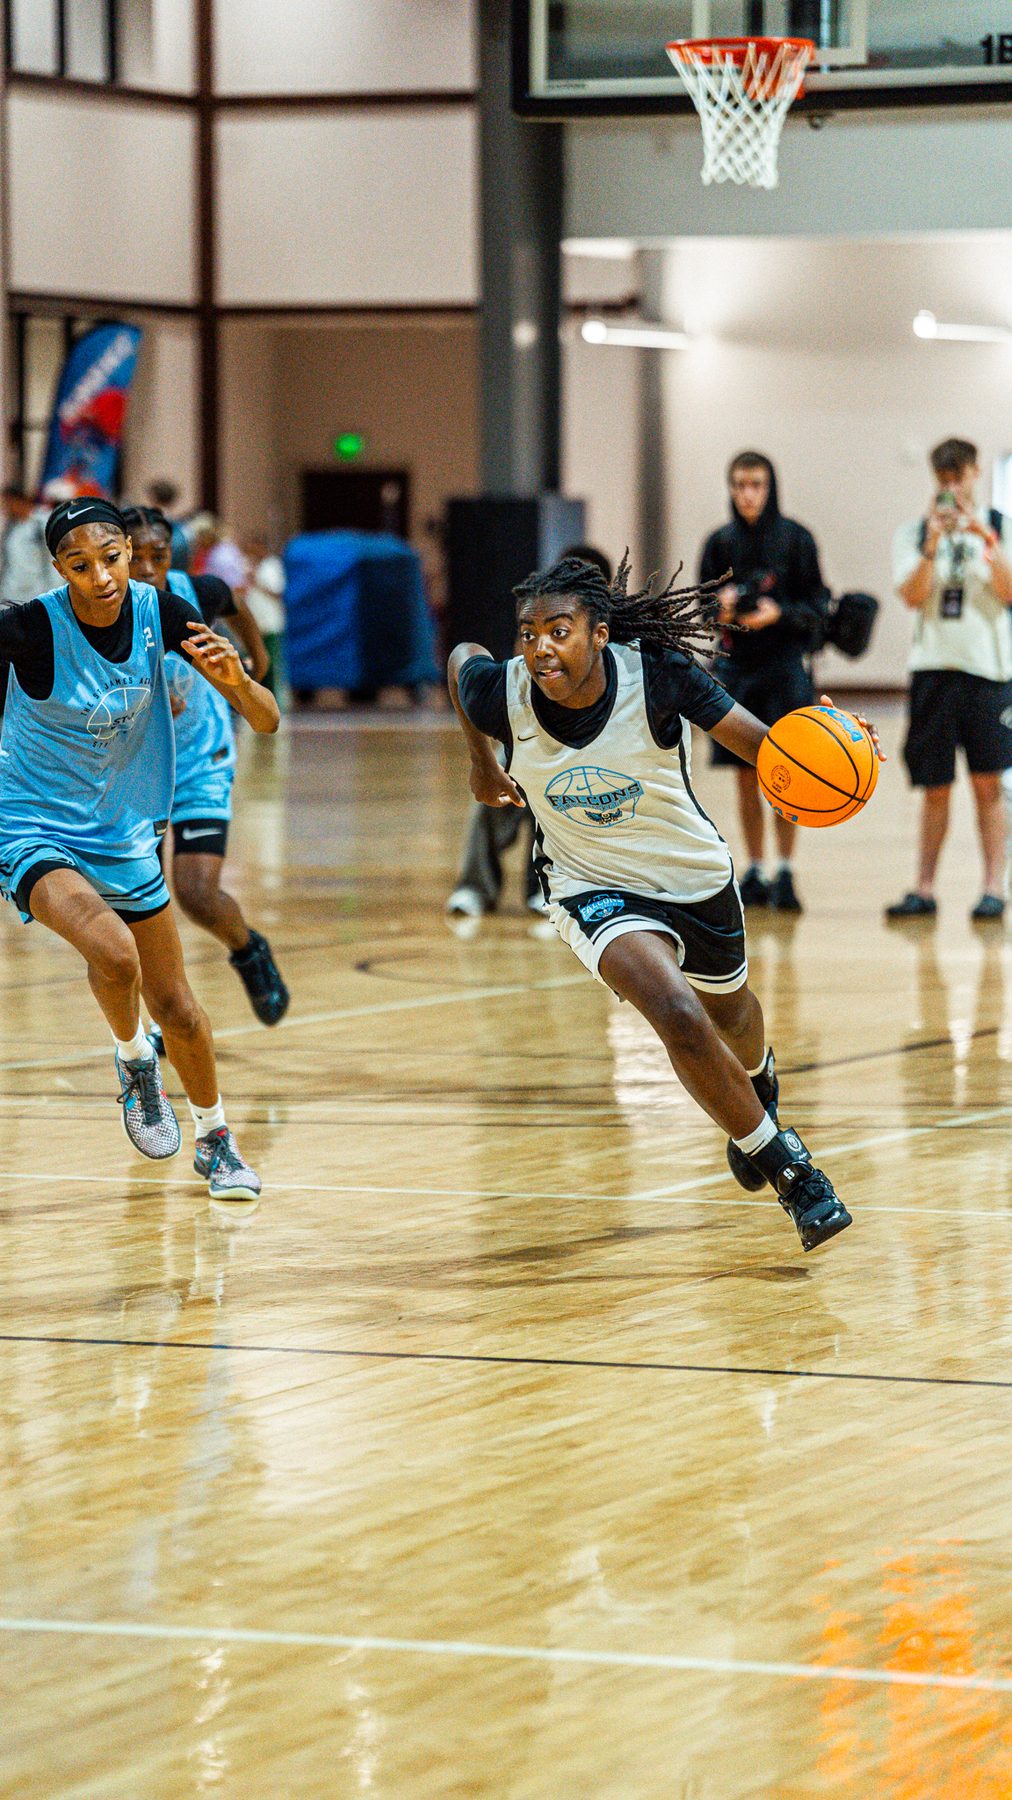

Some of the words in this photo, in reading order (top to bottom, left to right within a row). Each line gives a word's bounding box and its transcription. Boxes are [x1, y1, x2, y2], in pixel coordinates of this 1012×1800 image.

[81, 702, 94, 716] THE
[105, 677, 133, 689] JAMES
[547, 783, 641, 807] FALCONS
